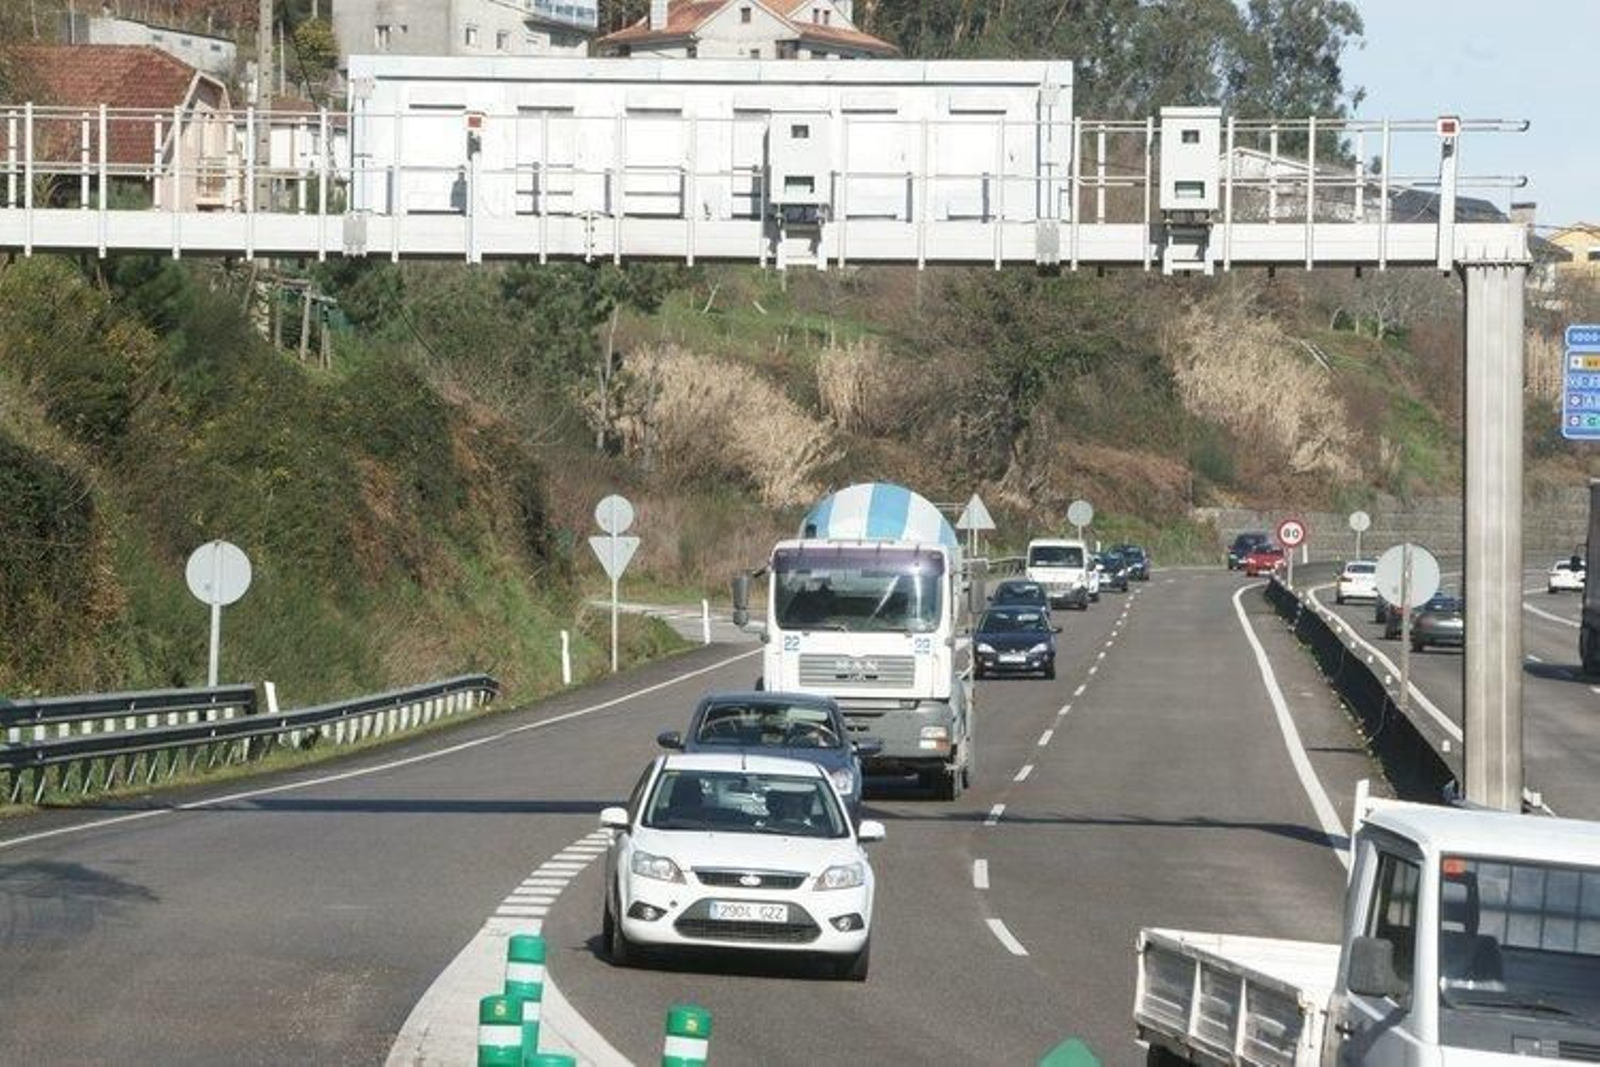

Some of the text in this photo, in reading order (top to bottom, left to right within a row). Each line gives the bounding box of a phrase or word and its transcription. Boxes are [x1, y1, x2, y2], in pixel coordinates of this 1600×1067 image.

[784, 635, 800, 651] 22
[914, 638, 930, 654] 22
[835, 660, 879, 671] MAN
